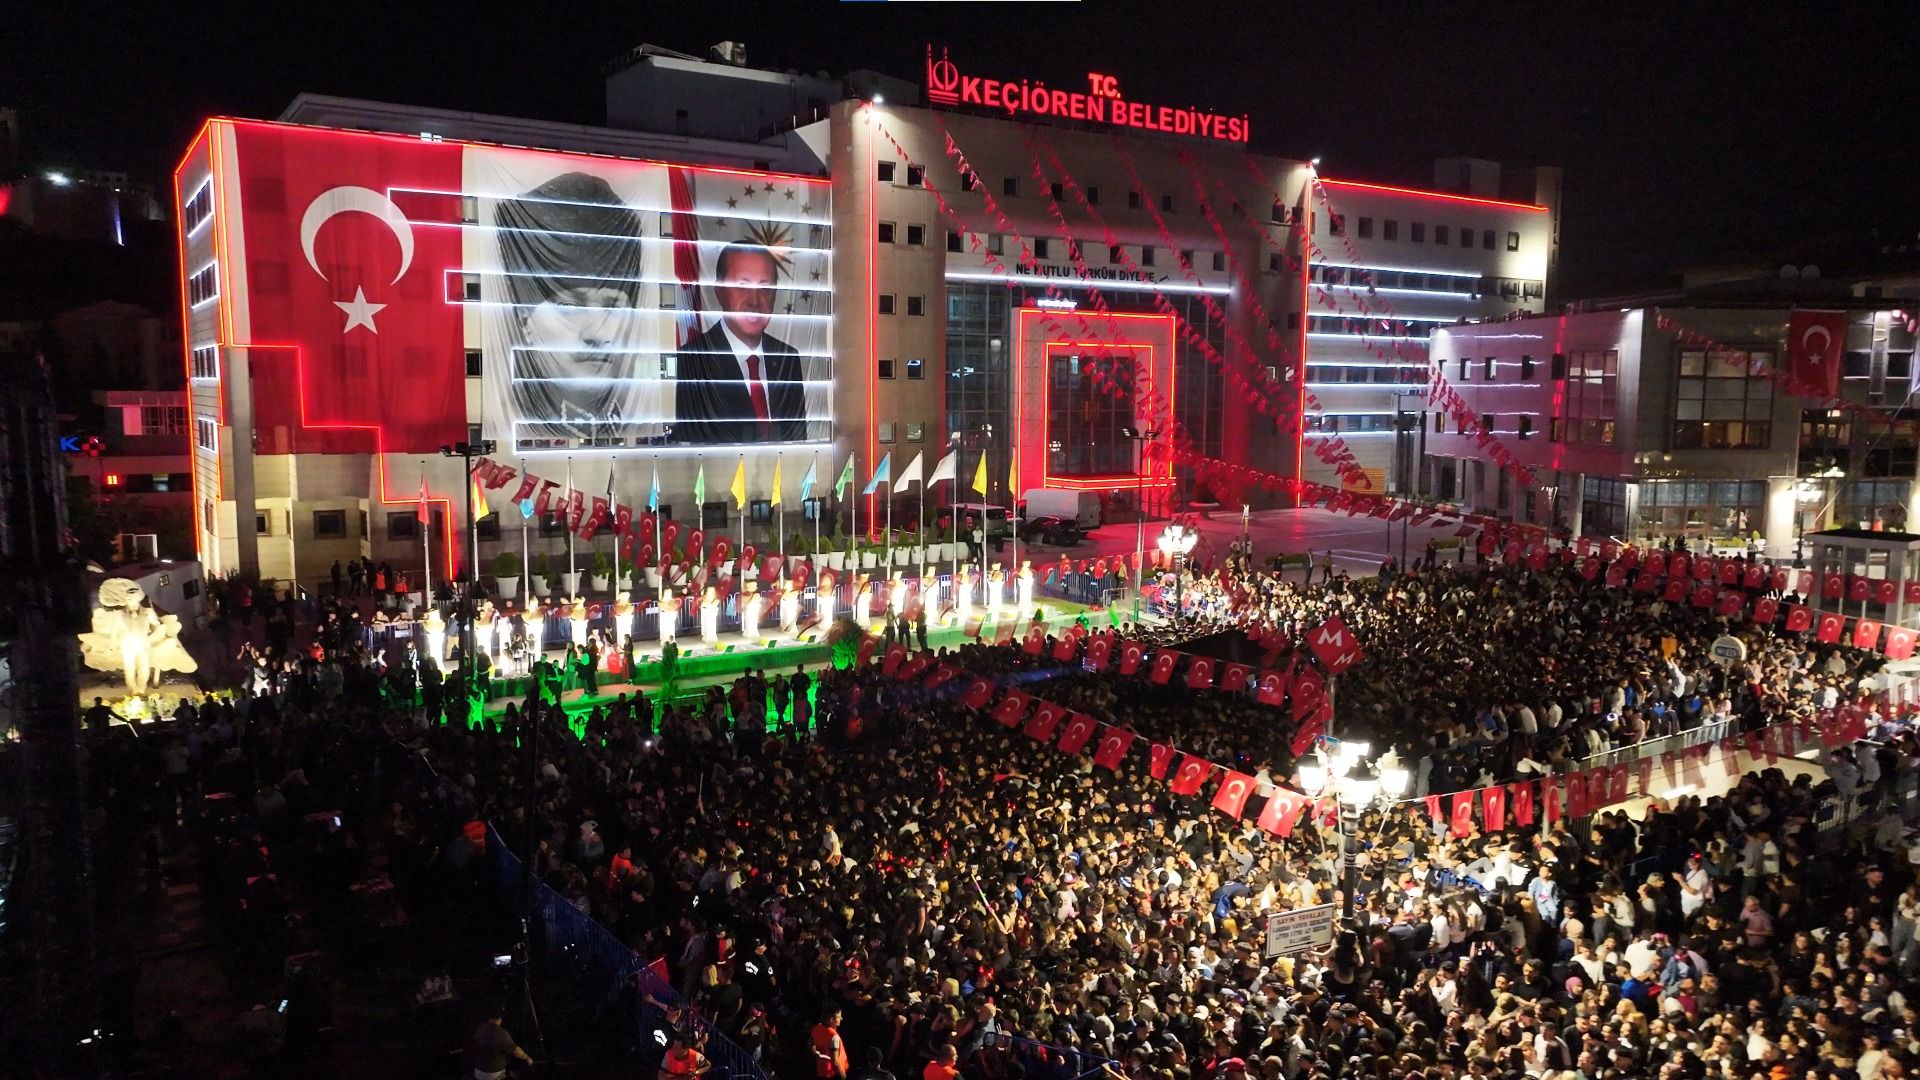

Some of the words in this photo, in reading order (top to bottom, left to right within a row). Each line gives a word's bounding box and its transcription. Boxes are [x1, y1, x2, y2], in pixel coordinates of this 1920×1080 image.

[1088, 72, 1121, 98] T.C.
[962, 75, 1104, 122] KEÇİÖREN
[1112, 100, 1249, 142] BELEDİYESİ
[1016, 263, 1030, 275] NE
[1119, 270, 1155, 283] DİYEE
[1317, 627, 1342, 647] M
[1333, 651, 1356, 666] M
